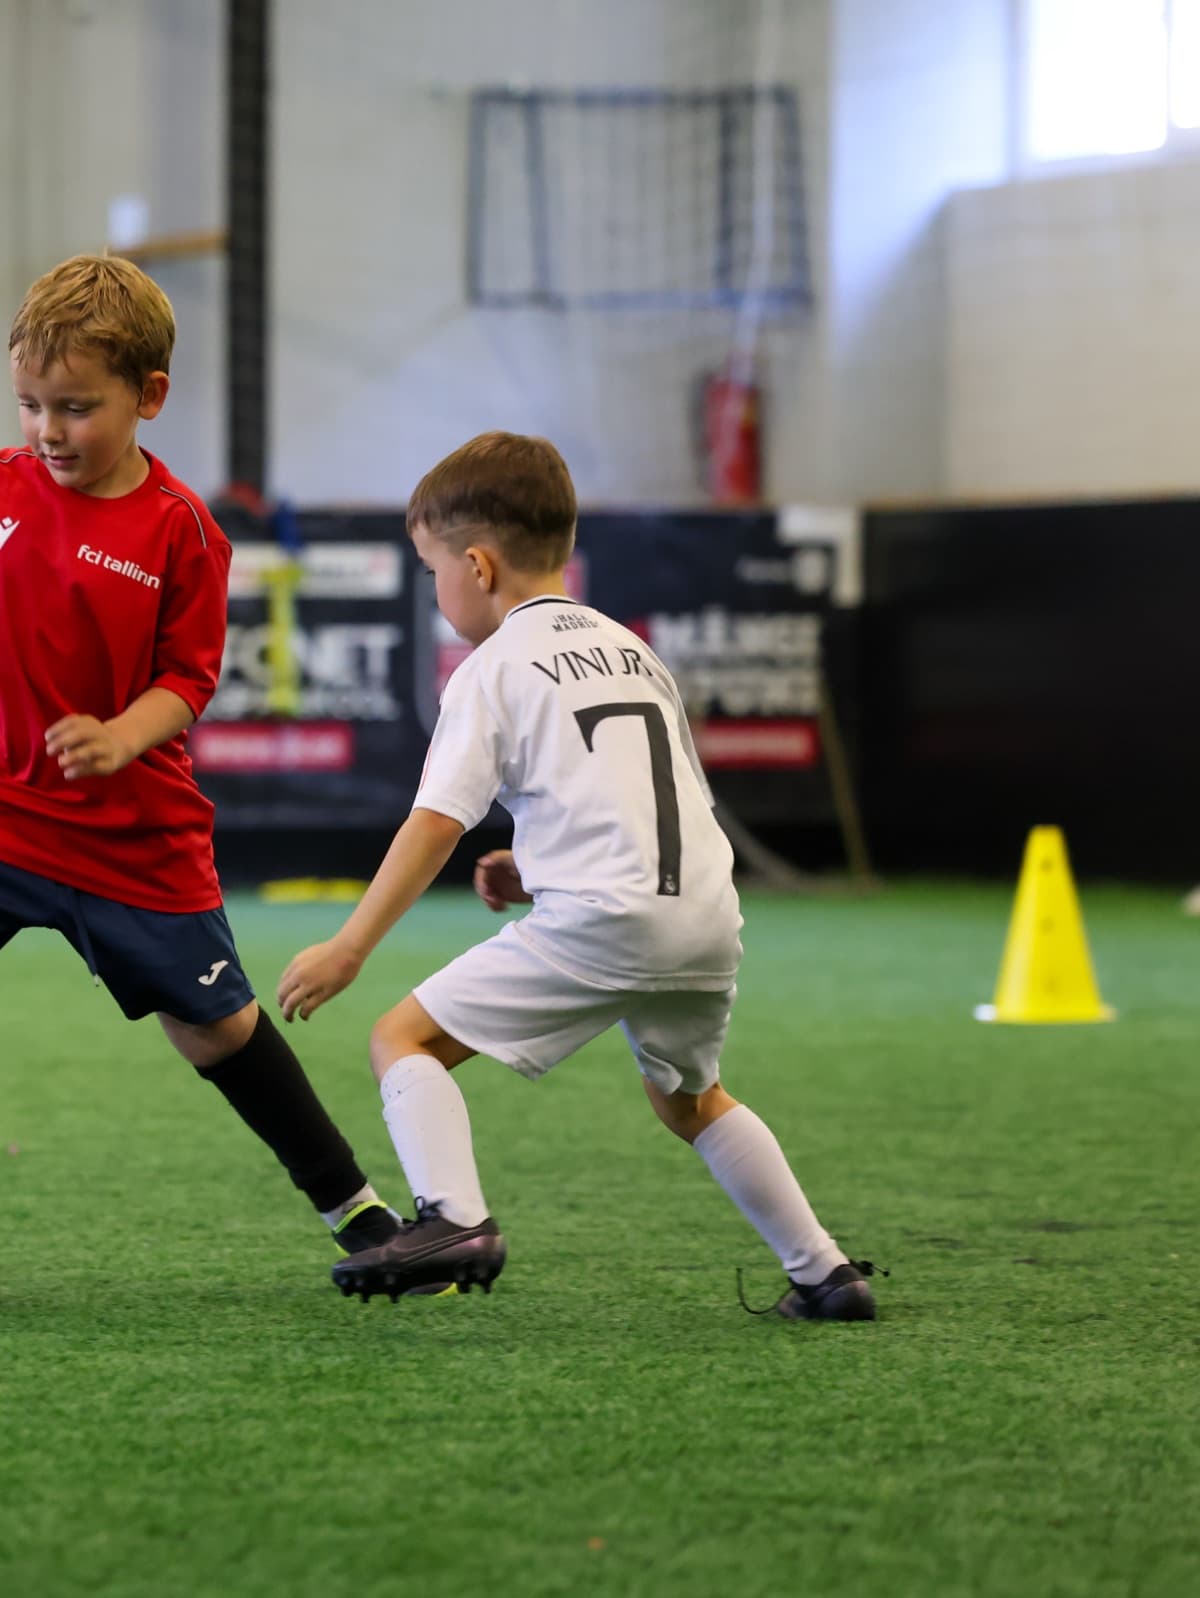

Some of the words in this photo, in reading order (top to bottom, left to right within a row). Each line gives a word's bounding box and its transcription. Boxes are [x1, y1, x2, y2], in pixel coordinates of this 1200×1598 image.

[77, 544, 103, 566] fci
[103, 554, 161, 590] tallinn
[531, 646, 614, 685] VINI
[573, 702, 682, 896] 7
